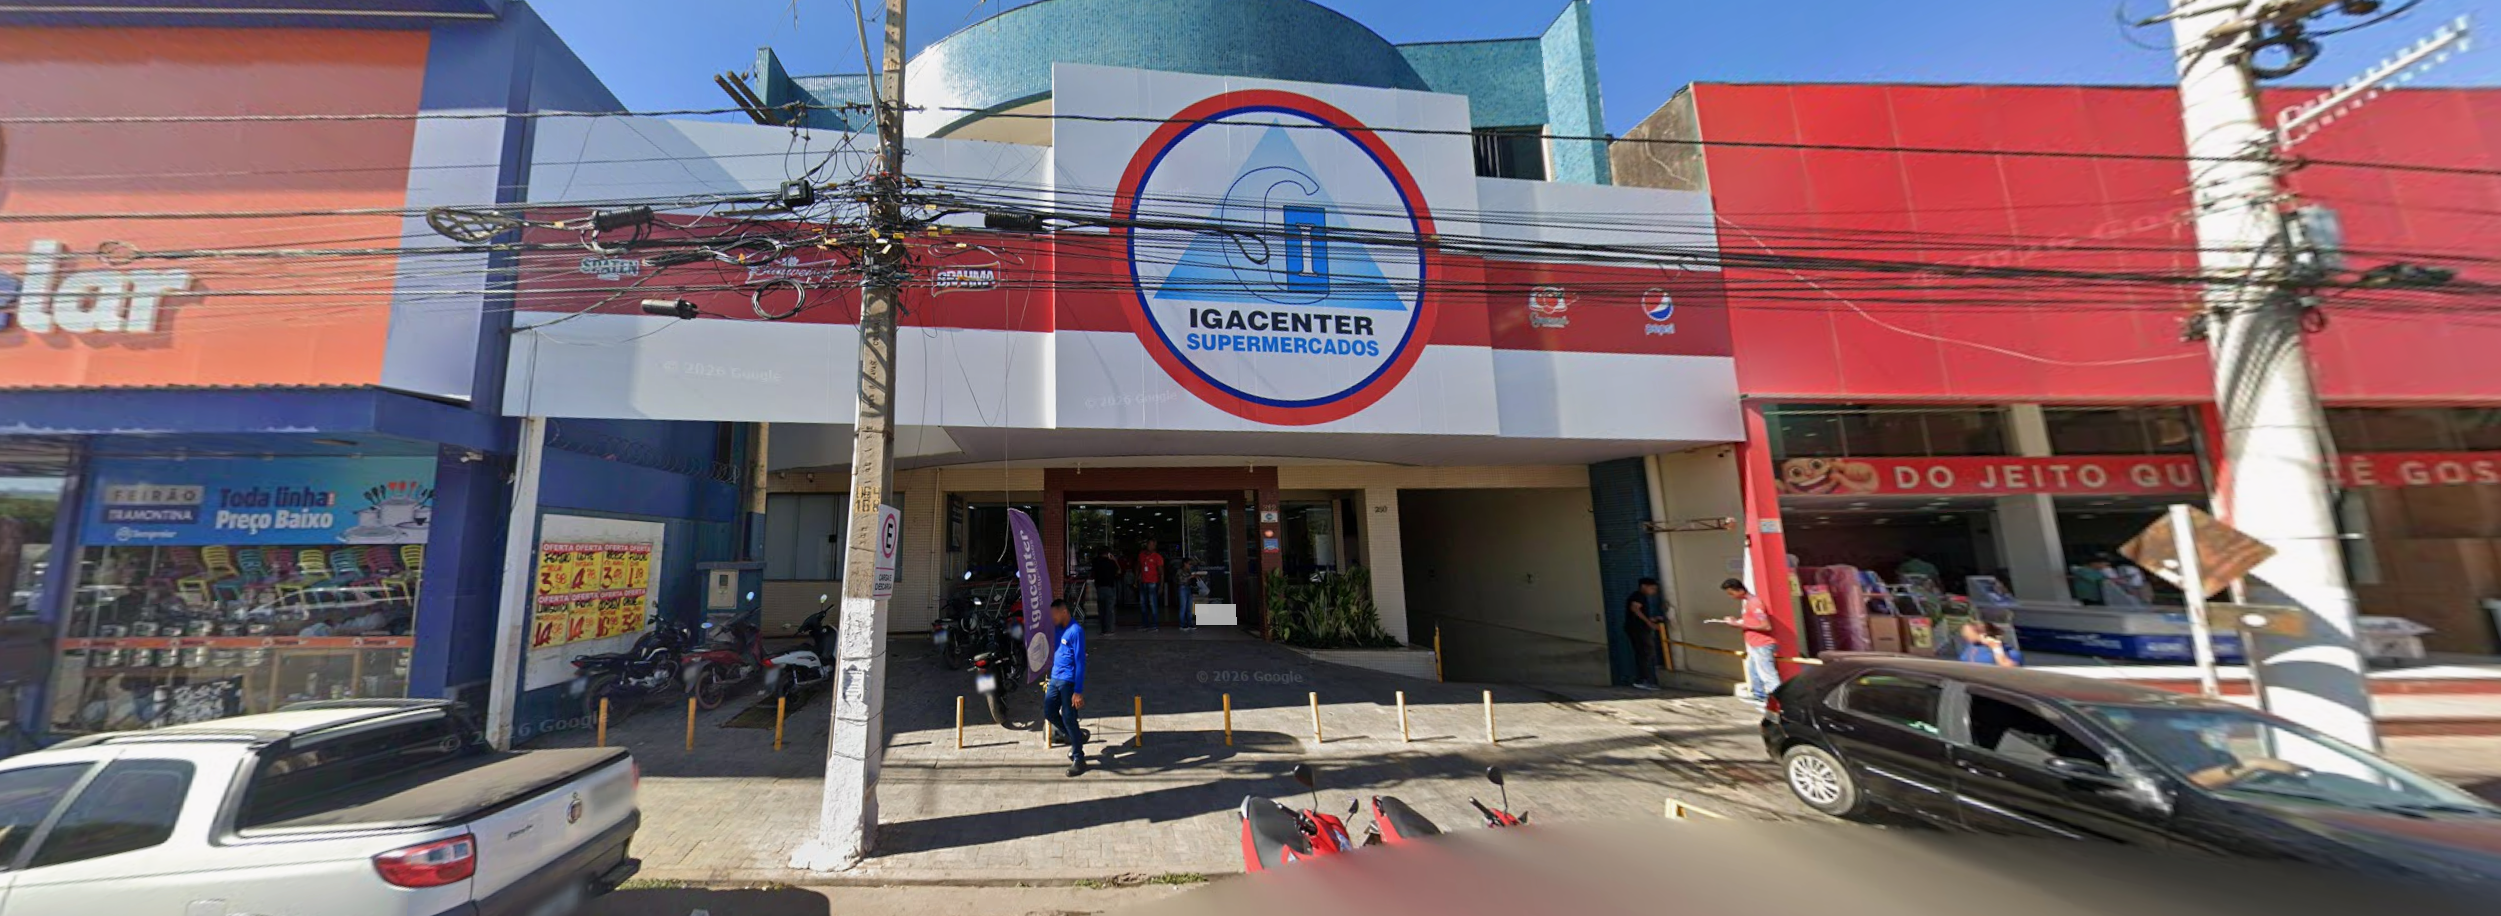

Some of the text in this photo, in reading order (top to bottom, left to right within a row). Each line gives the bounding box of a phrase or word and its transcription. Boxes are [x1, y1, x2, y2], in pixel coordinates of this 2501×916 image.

[936, 269, 996, 287] BRAHMA
[1189, 307, 1375, 336] IGACENTER
[1644, 322, 1676, 336] pepsi
[1186, 332, 1380, 357] SUPERMERCADOS
[1893, 465, 1954, 489] DO
[1979, 463, 2108, 489] JEITO
[114, 486, 197, 502] FEIRÃO
[219, 486, 329, 508] Toda linha
[108, 509, 193, 521] TRAMONTINA
[215, 507, 334, 535] Preço Baixo
[885, 522, 894, 549] E
[543, 544, 574, 552] OFERTA
[575, 544, 603, 552] OFERTA
[604, 544, 629, 552] OFERTA
[1019, 529, 1042, 631] igacenter
